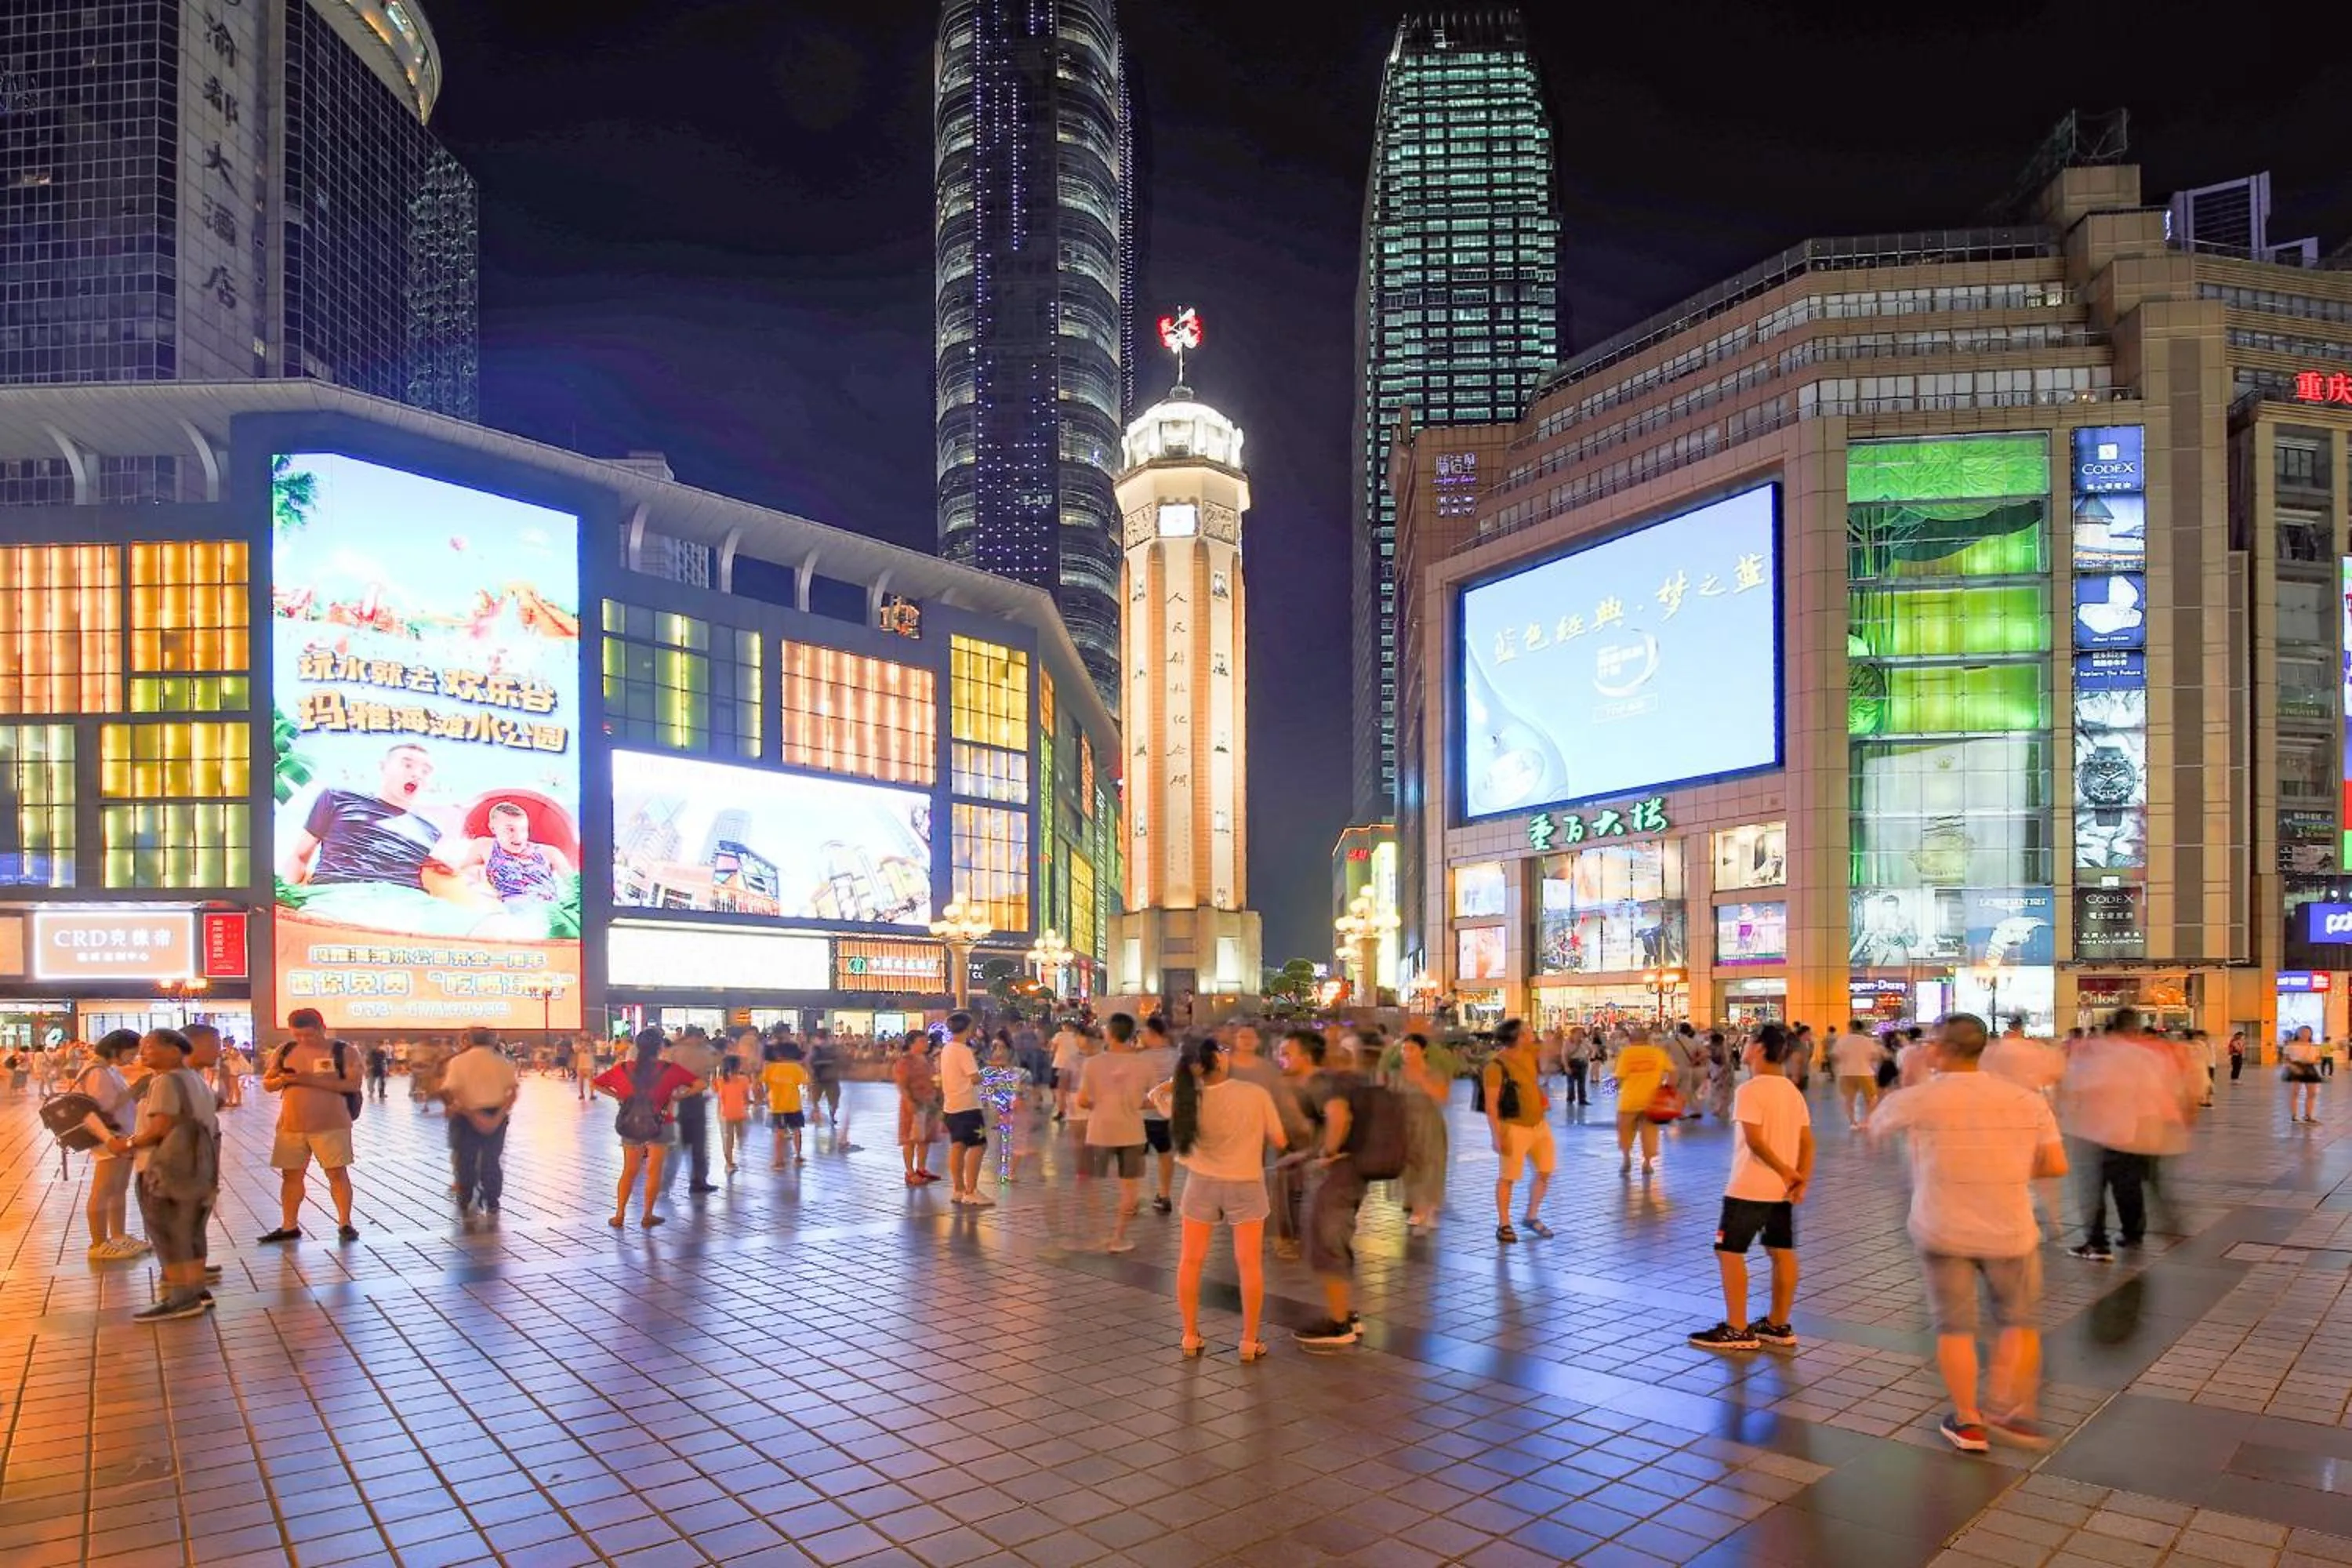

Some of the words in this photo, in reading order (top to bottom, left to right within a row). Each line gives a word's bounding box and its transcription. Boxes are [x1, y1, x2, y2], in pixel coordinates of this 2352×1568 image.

[201, 11, 240, 310] 渝都大酒店
[2082, 462, 2136, 474] CODEX
[297, 687, 569, 755] 玛雅海滩水公园
[2085, 894, 2134, 904] CODEX
